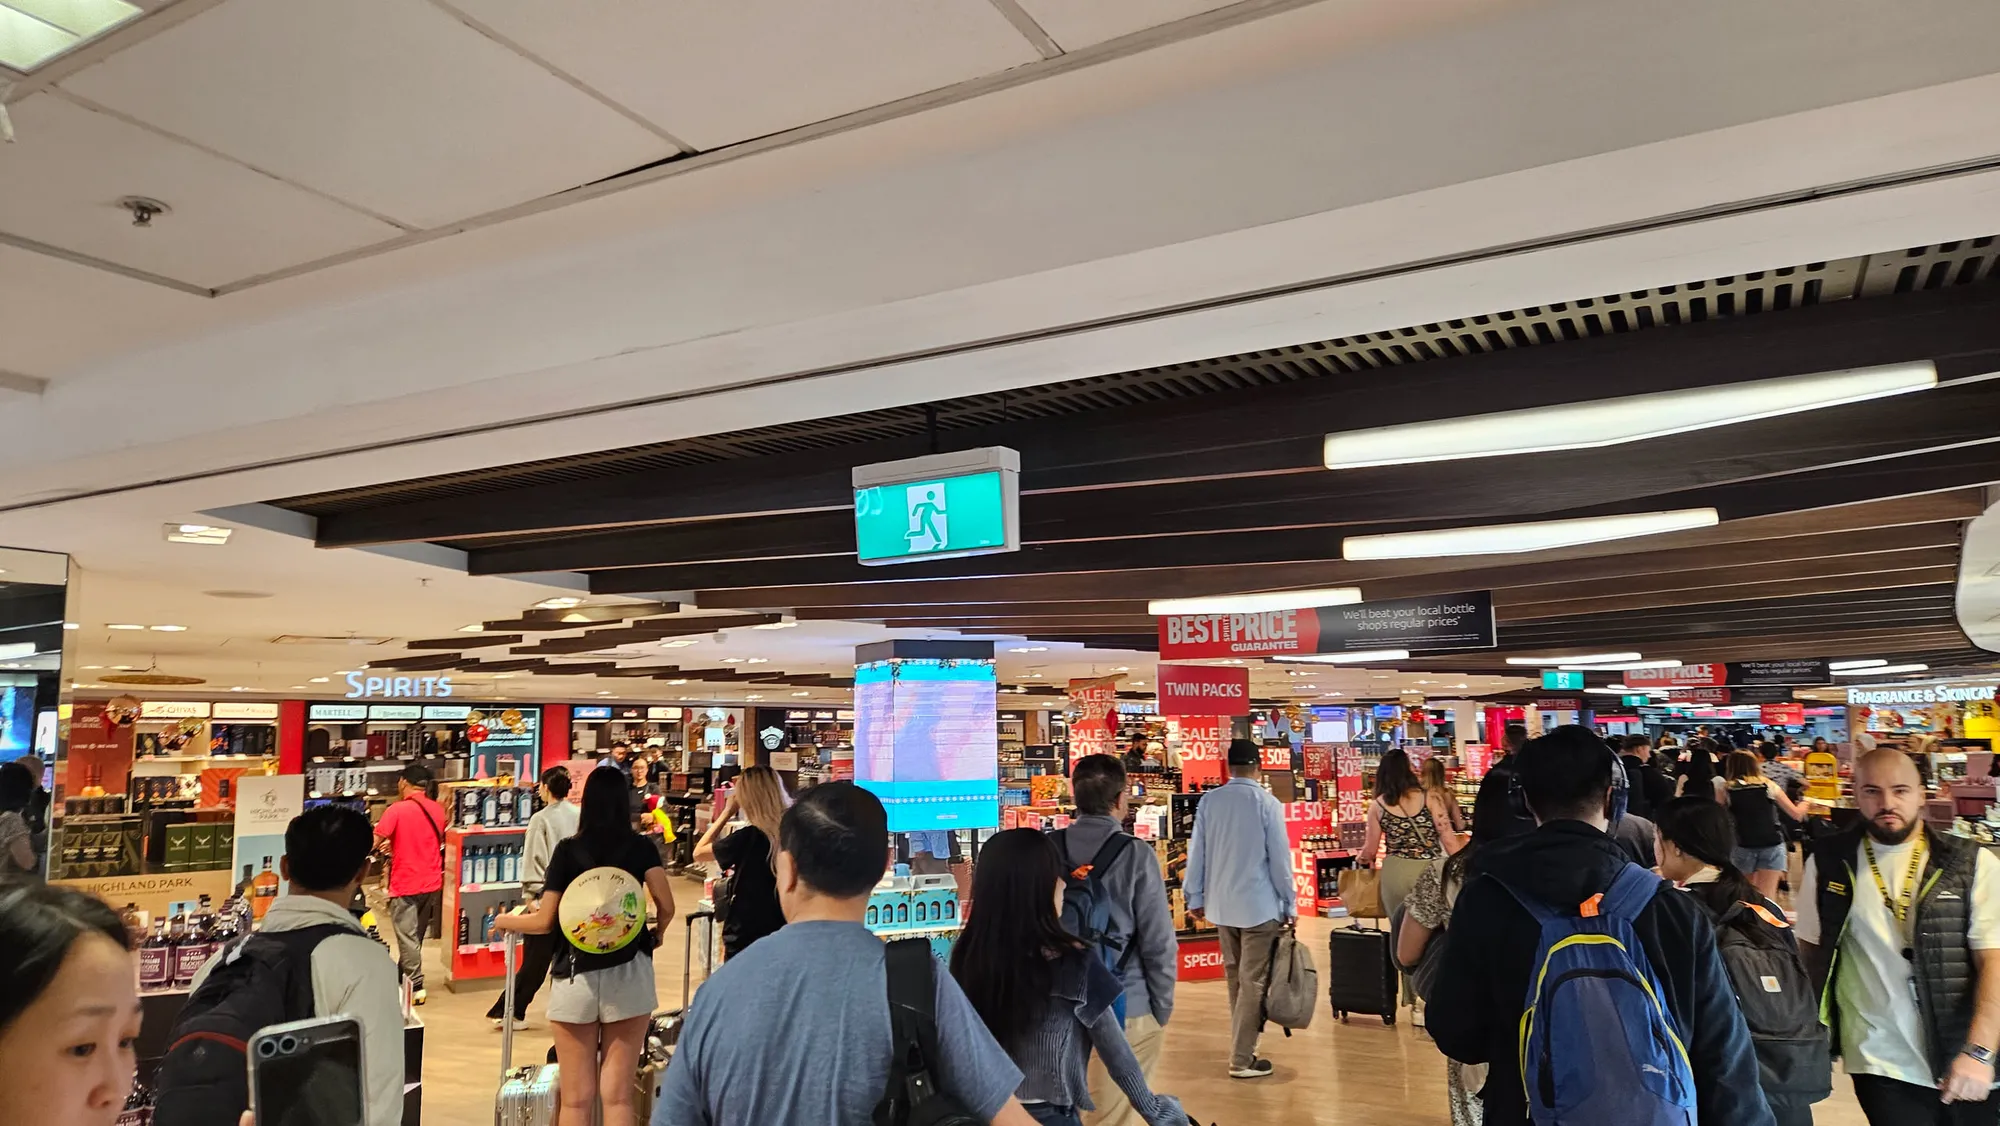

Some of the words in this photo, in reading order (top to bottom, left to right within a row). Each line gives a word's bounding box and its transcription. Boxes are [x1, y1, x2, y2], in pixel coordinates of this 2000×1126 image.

[1342, 609, 1367, 620] We'll
[1368, 608, 1392, 618] beat
[1392, 607, 1416, 620] your
[1417, 604, 1441, 616] local
[1443, 603, 1476, 614] bottle
[1167, 614, 1223, 645] BEST
[1230, 609, 1298, 642] PRICE
[1357, 619, 1389, 632] shop's
[1389, 617, 1426, 631] regular
[1231, 640, 1299, 652] GUARANTEE
[1671, 663, 1714, 679] PRICE
[1069, 690, 1102, 702] SALE
[1164, 682, 1200, 697] TWIN
[1202, 683, 1243, 698] PACKS
[1923, 689, 1936, 702] &
[1069, 729, 1103, 742] SALE
[1181, 727, 1219, 741] SALE
[1069, 741, 1103, 760] 50%
[1182, 741, 1219, 761] 50%
[1336, 747, 1362, 760] SALE
[1338, 790, 1364, 803] SALE
[87, 880, 157, 893] HIGHLAND
[159, 877, 193, 889] PARK
[1297, 898, 1315, 908] OFF
